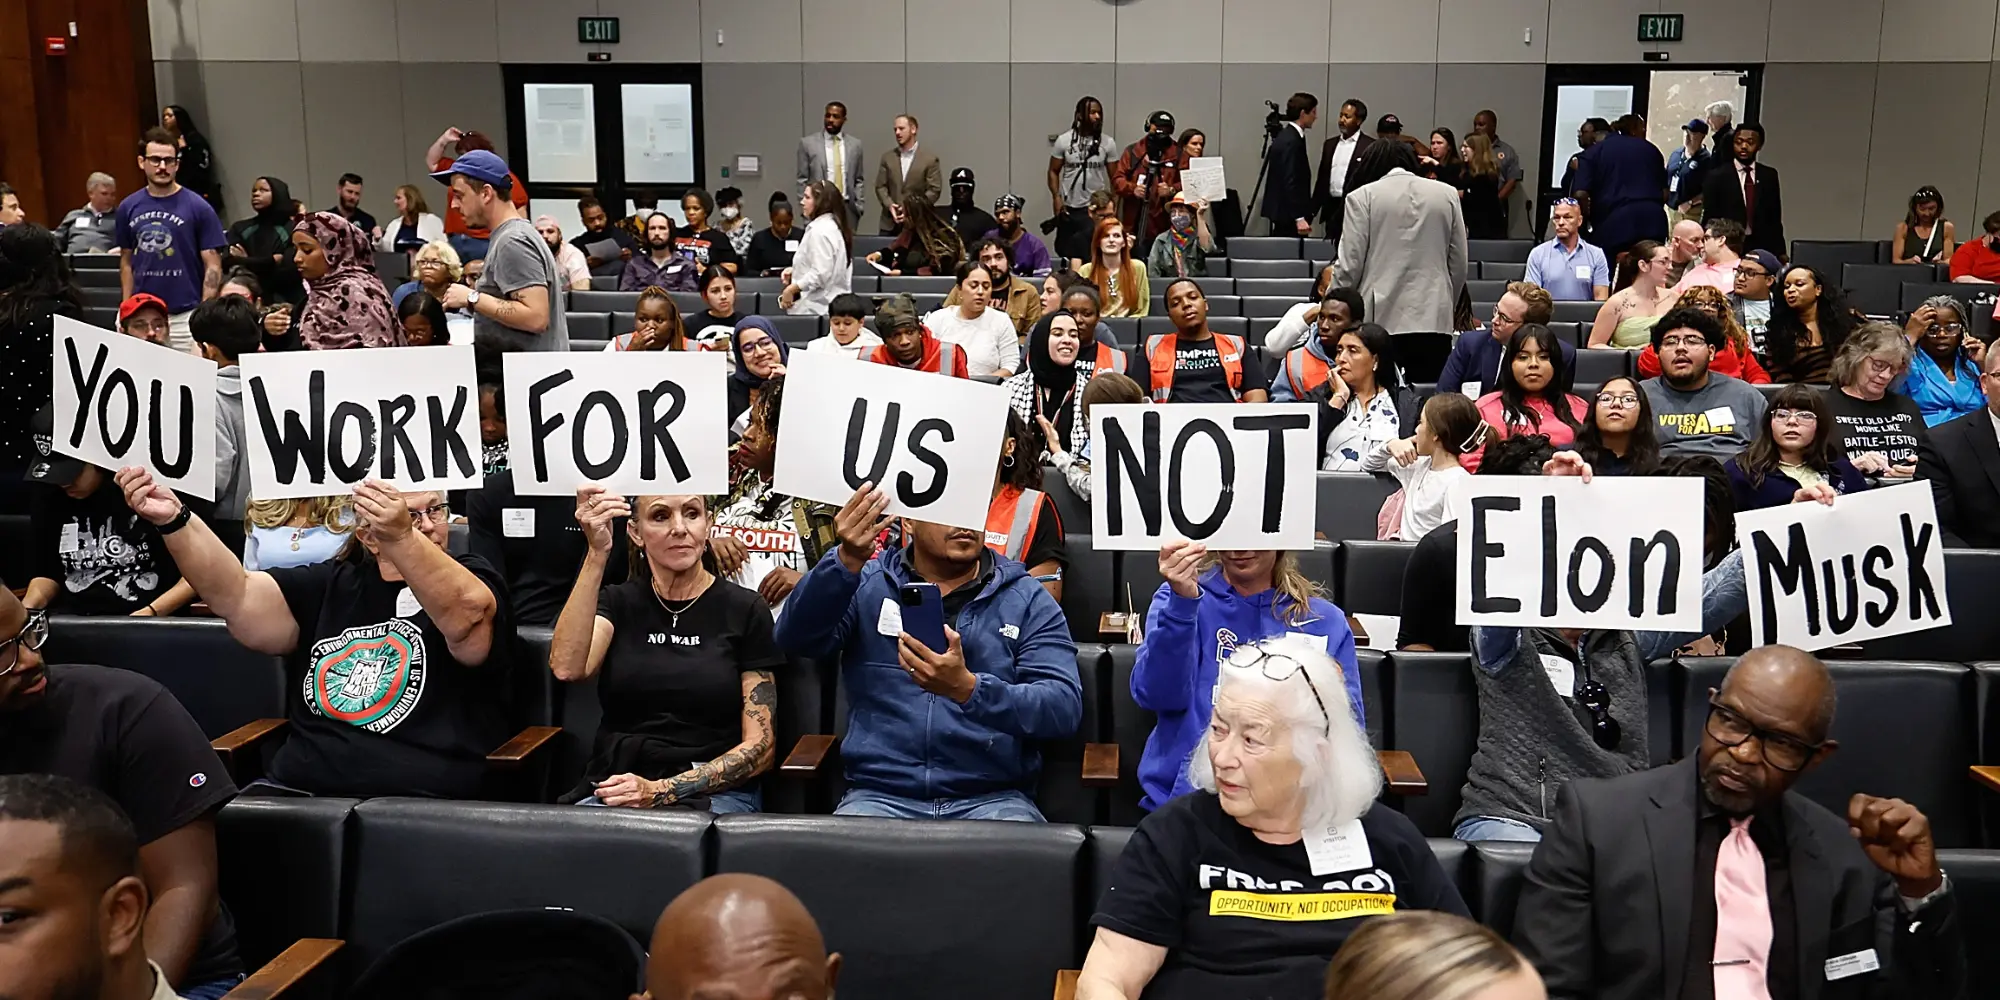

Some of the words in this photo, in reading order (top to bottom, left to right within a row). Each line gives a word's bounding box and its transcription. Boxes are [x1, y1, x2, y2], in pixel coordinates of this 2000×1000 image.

[585, 20, 612, 40] EXIT
[1647, 18, 1676, 38] EXIT
[169, 214, 185, 226] MY
[64, 336, 194, 479] YOU
[249, 370, 476, 485] WORK
[529, 369, 691, 483] FOR
[1659, 414, 1697, 427] VOTES
[1836, 416, 1864, 424] SWEET
[1865, 417, 1883, 425] OLD
[1884, 413, 1912, 423] LADY?
[1881, 423, 1902, 432] LIKE
[1678, 425, 1693, 435] FOR
[1844, 435, 1918, 448] BATTLE-TESTED
[843, 397, 955, 508] US
[1102, 411, 1310, 540] NOT
[109, 539, 121, 554] 6
[734, 529, 795, 550] SOUTH
[1471, 495, 1681, 618] Elon
[318, 625, 387, 655] ENVIRONMENTAL
[647, 633, 666, 644] NO
[670, 635, 700, 646] WAR
[410, 669, 423, 681] US
[1216, 897, 1295, 915] OPPORTUNITY,
[1299, 901, 1318, 914] NOT
